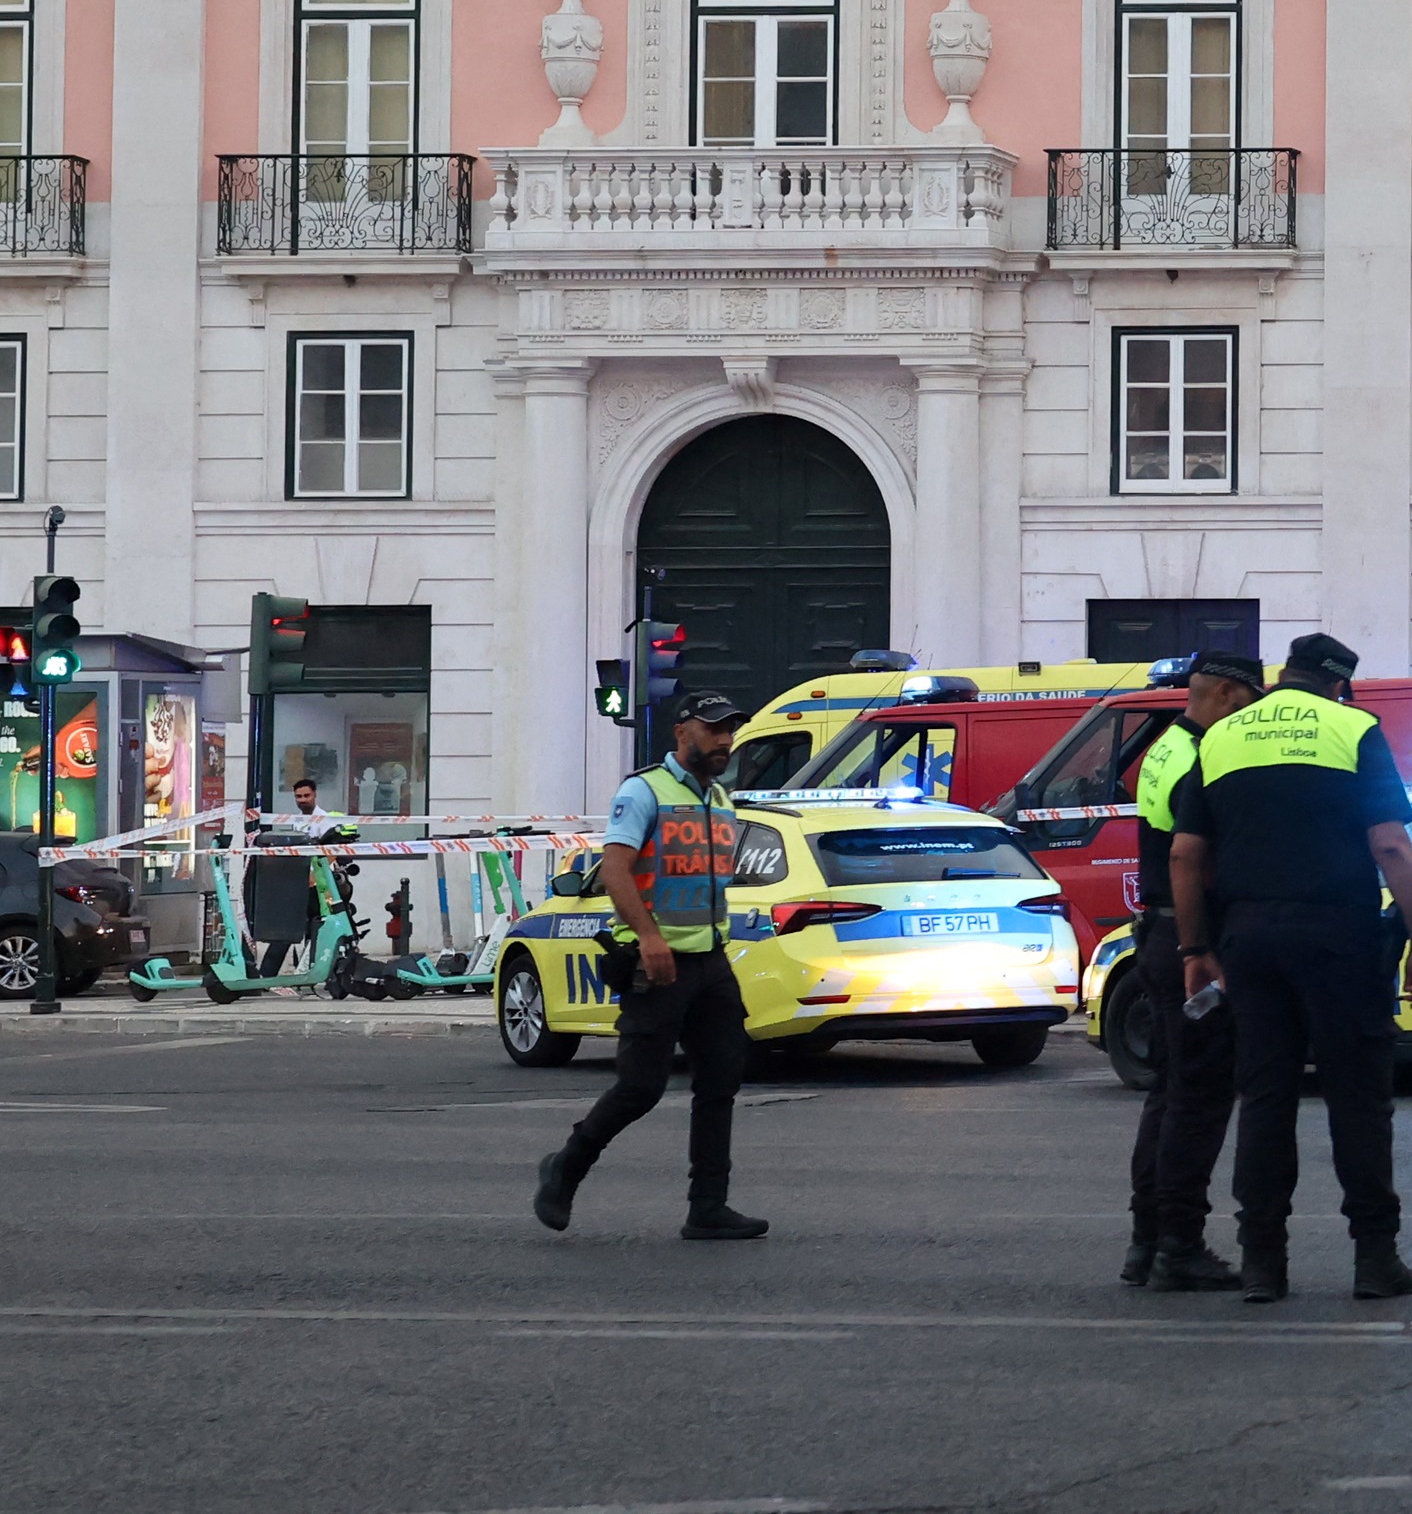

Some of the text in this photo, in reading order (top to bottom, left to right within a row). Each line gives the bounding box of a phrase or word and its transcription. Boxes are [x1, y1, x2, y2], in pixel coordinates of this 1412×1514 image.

[1227, 705, 1319, 730] POLÍCIA
[1244, 727, 1318, 742] municipal
[80, 732, 94, 763] SAFARI
[1281, 747, 1317, 758] Lisboa
[920, 914, 990, 933] BF 57 PH
[481, 940, 500, 967] Lime
